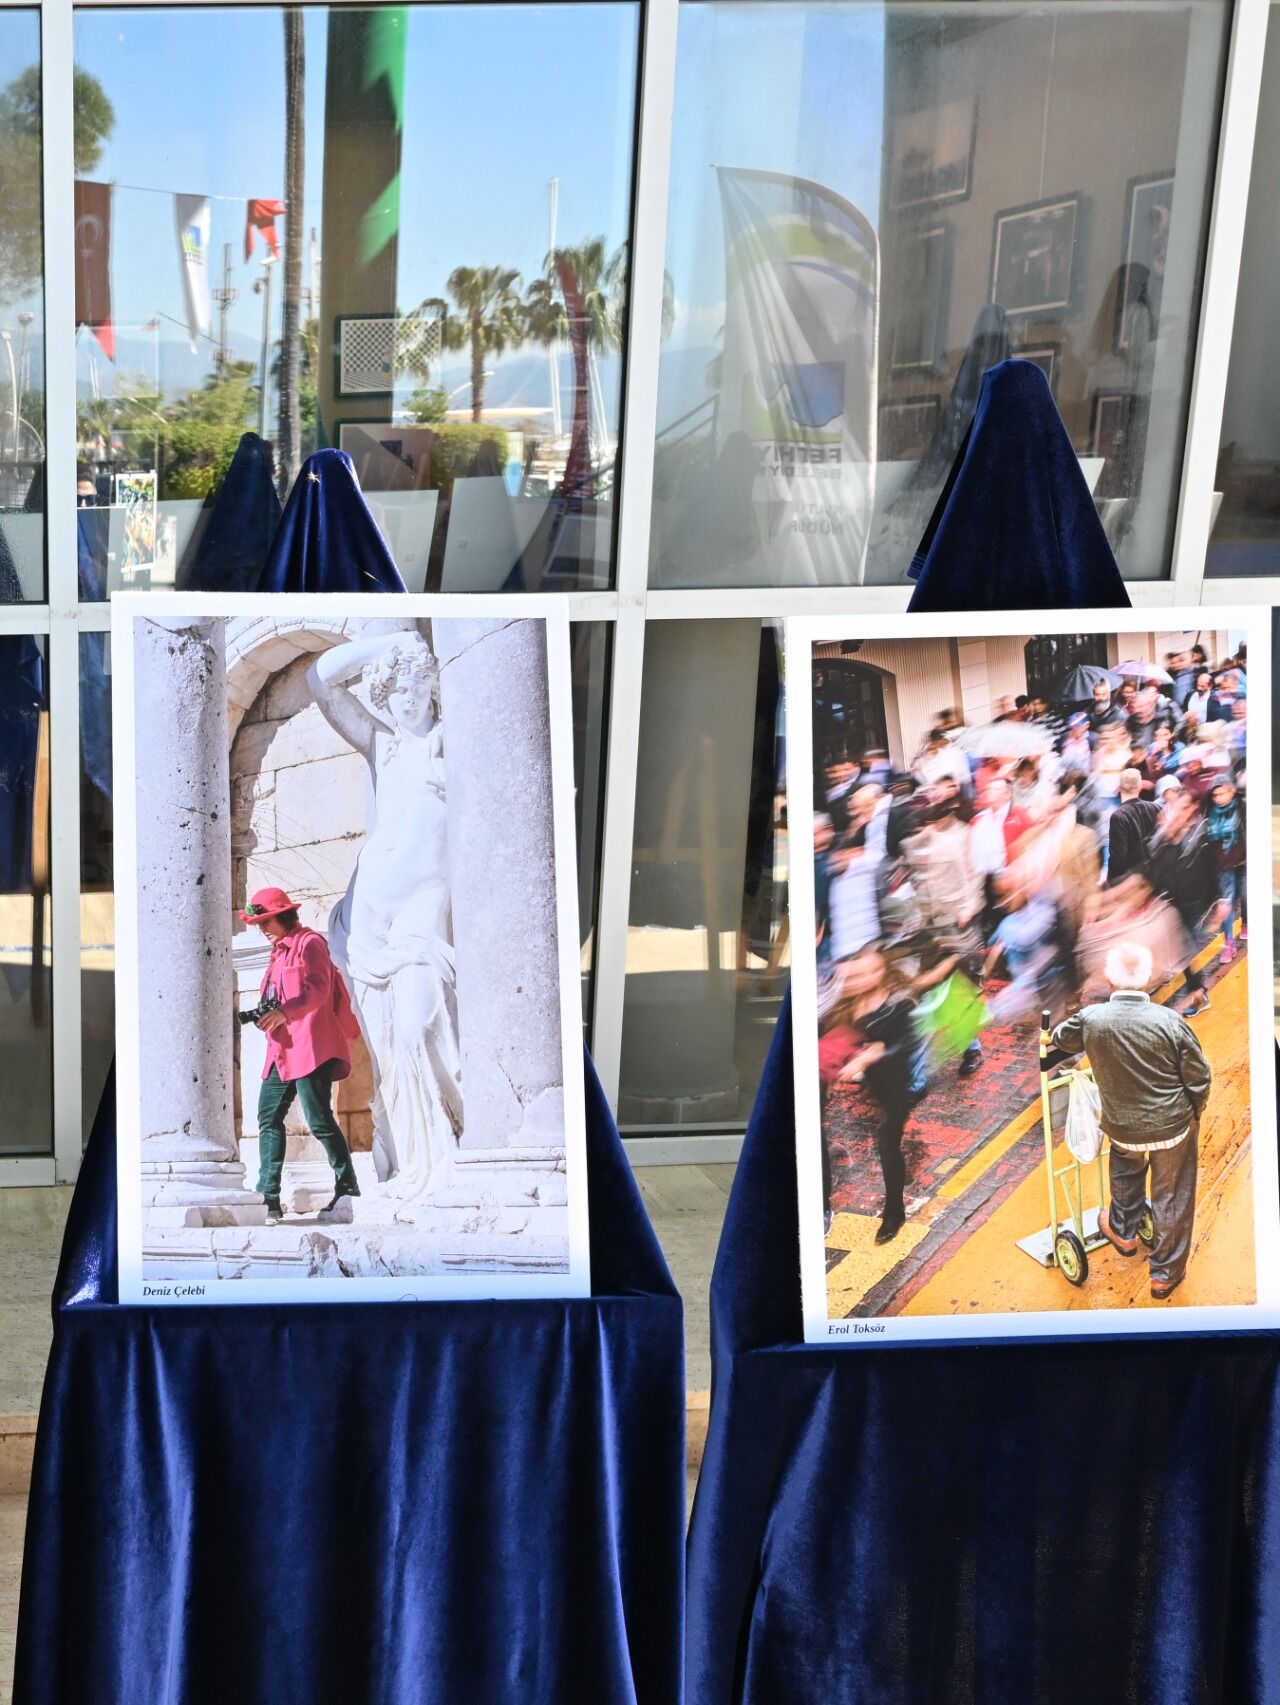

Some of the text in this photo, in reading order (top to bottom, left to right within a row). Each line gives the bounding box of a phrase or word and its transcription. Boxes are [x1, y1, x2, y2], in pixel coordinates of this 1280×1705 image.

[143, 1285, 205, 1298] Deniz Çelebi
[828, 1323, 886, 1334] Erol Toksöz
